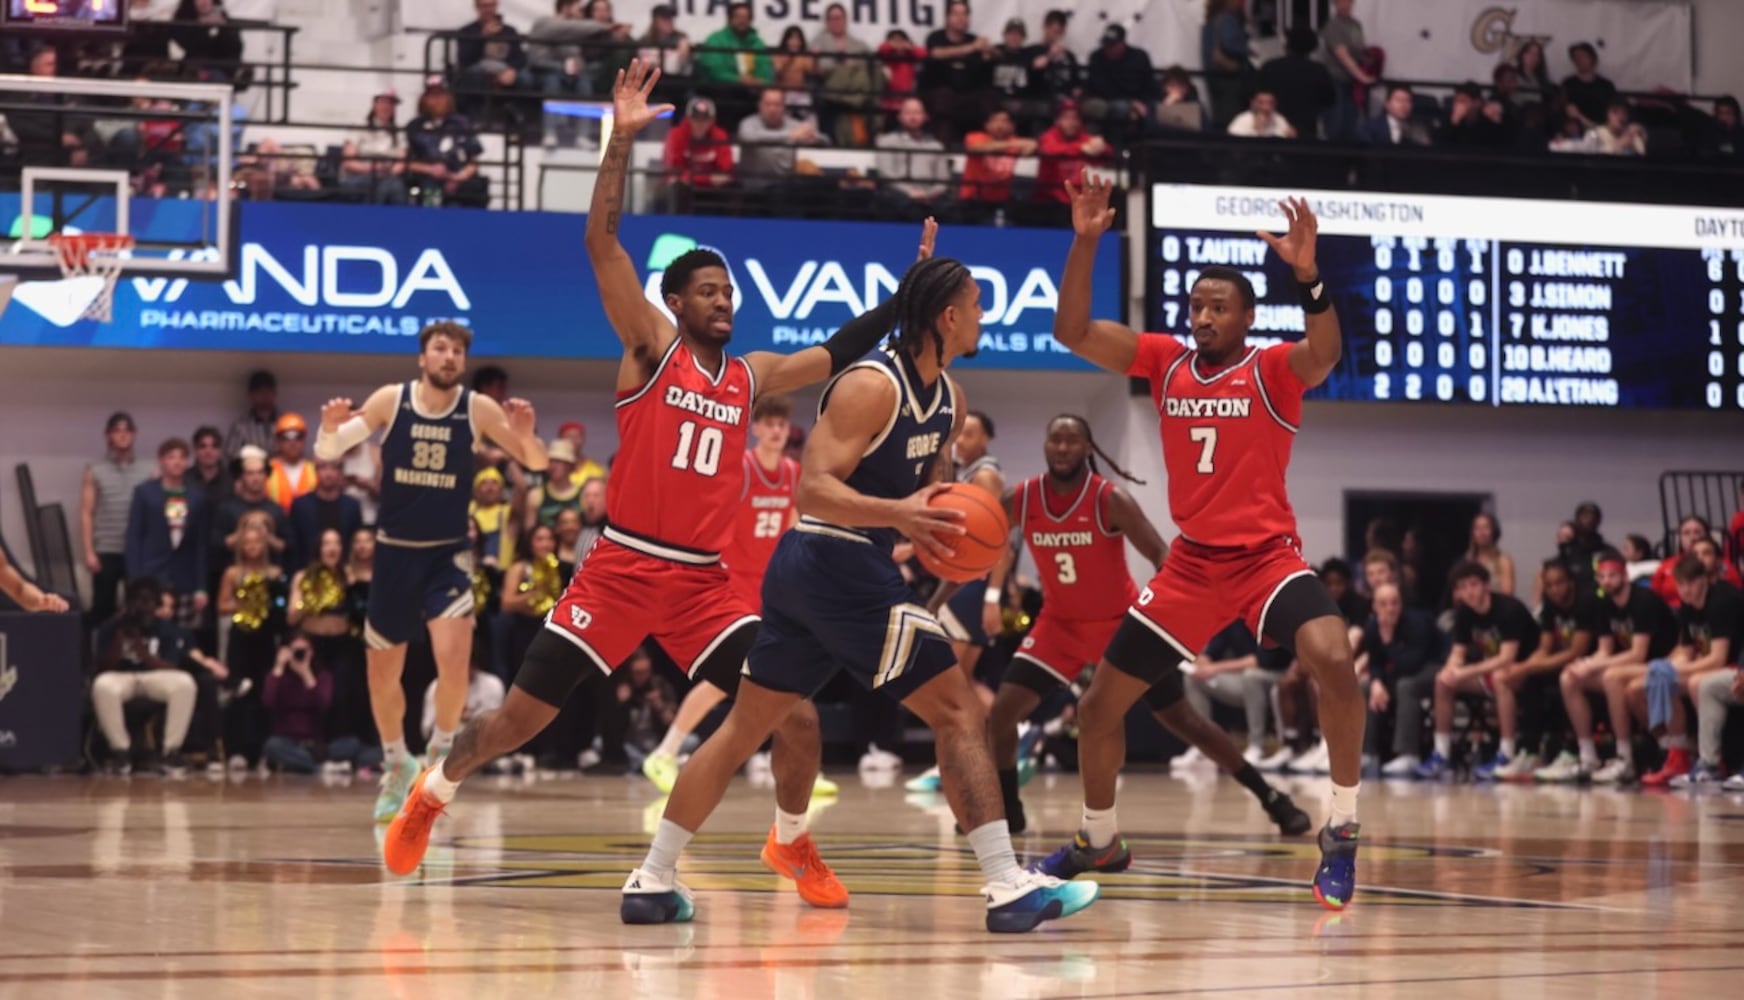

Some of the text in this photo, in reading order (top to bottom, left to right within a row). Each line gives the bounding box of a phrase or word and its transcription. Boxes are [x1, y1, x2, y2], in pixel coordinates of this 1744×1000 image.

[853, 0, 935, 25] HIG
[1216, 196, 1423, 222] GEORG ASHINGTON
[1162, 235, 1268, 265] 0 T.AUTRY
[1375, 245, 1483, 274] 0 1 0 1
[1508, 248, 1627, 278] 0 J.BENNETT
[1163, 269, 1180, 295] 2
[1375, 276, 1485, 305] 0 0 0 0
[1509, 281, 1612, 310] 3 J.SIMON
[1163, 301, 1179, 328] 7
[1709, 288, 1724, 314] 0
[141, 309, 419, 336] PHARMACEUTICALS
[1375, 308, 1483, 337] 0 0 0 1
[1509, 312, 1608, 341] 7 K.JONES
[1709, 319, 1722, 345] 1
[1375, 340, 1485, 369] 0 0 0 0
[1504, 344, 1528, 370] 10
[1708, 351, 1724, 377] 0
[1374, 372, 1485, 401] 2 2 0 0
[1706, 382, 1722, 408] 0
[665, 385, 742, 426] DAYTON
[1166, 397, 1251, 417] DAYTON
[410, 423, 451, 442] GEORGE
[412, 441, 447, 471] 33
[671, 420, 723, 477] 10
[1190, 427, 1217, 473] 7
[754, 511, 782, 538] 29
[1032, 531, 1093, 547] DAYTON
[1055, 551, 1077, 585] 3
